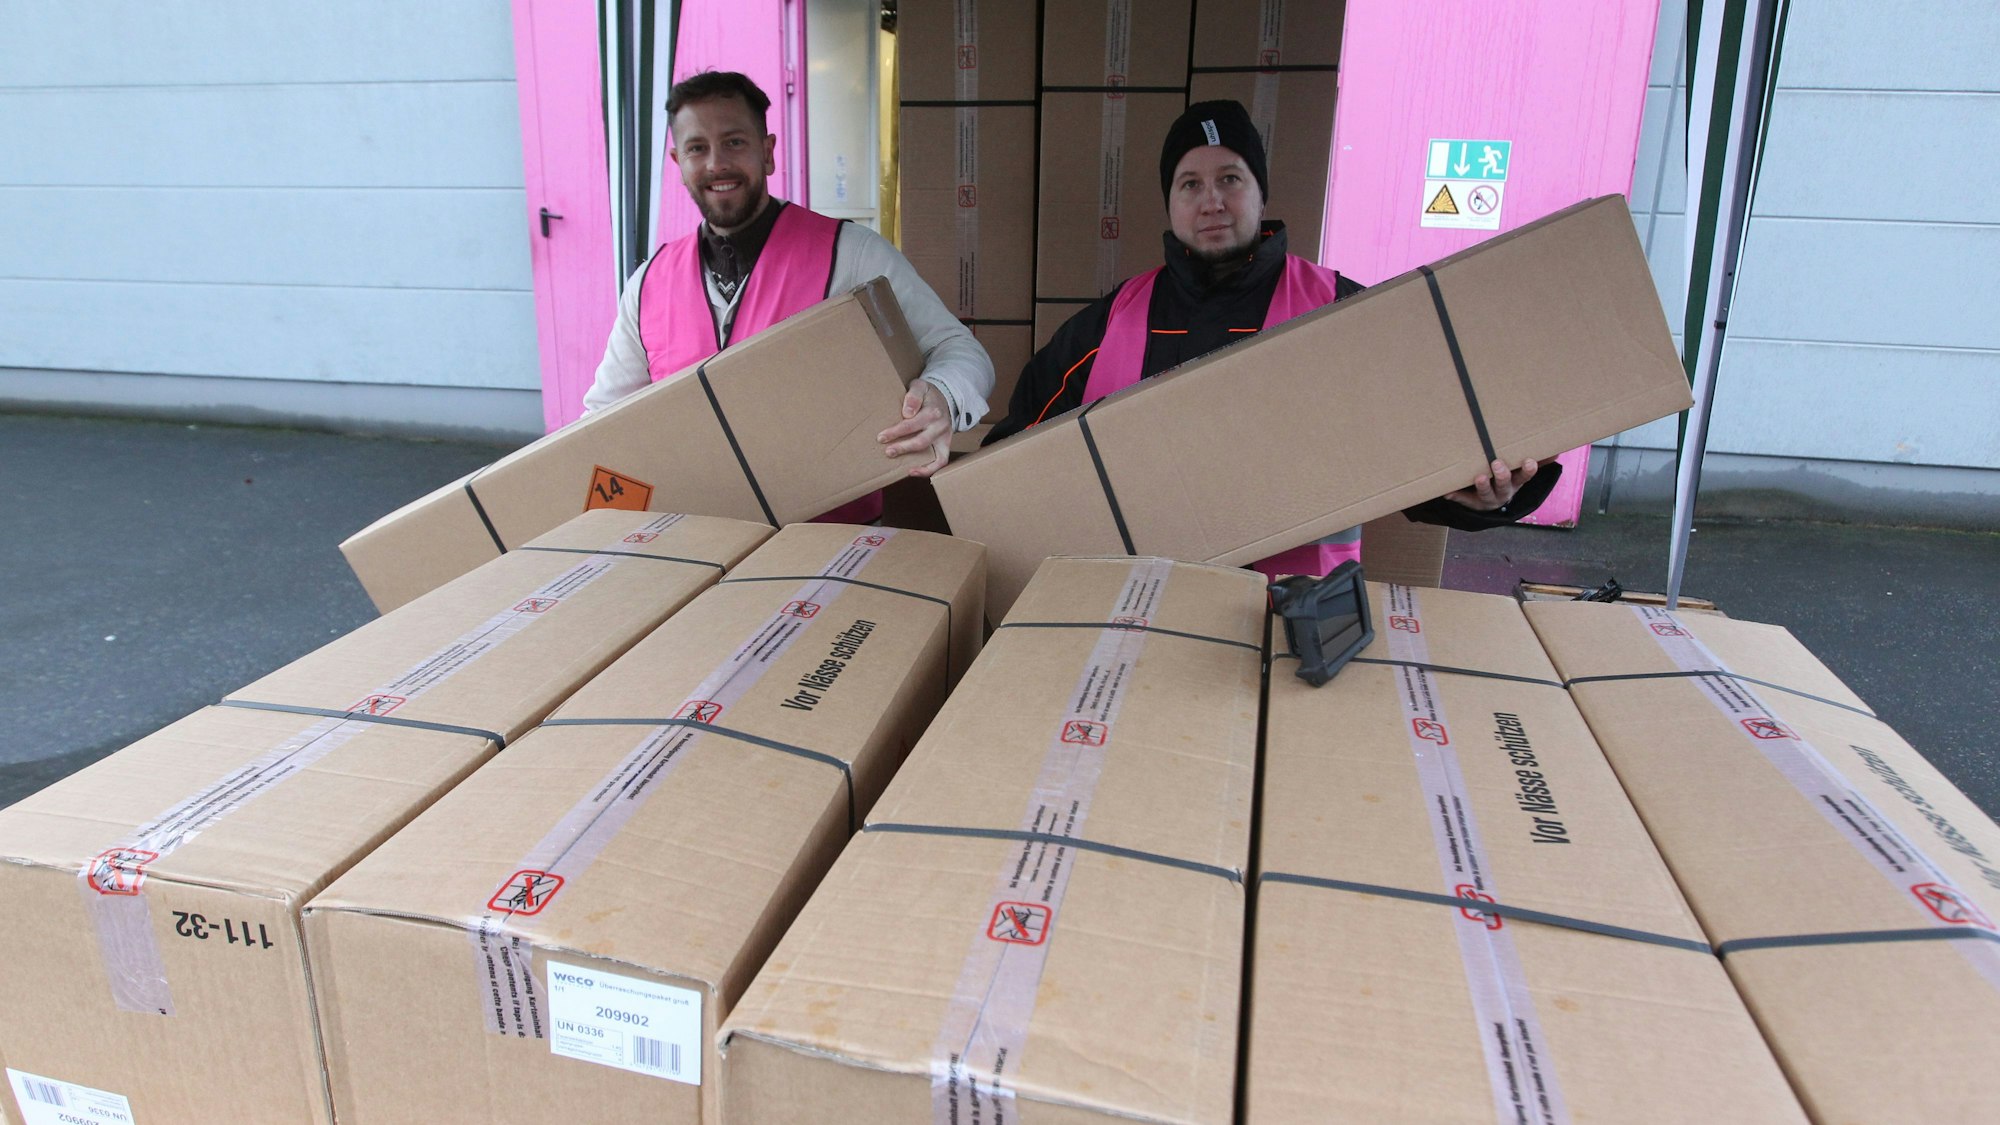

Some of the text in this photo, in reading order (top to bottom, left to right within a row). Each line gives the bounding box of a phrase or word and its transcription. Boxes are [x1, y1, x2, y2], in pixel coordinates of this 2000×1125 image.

[595, 476, 624, 503] 1.4
[830, 620, 876, 660] schützen
[798, 659, 846, 692] Nässe
[781, 690, 821, 711] Vor
[1493, 712, 1571, 844] Vor Nässe schützen
[1850, 744, 1934, 810] schützen
[1917, 807, 1991, 863] Nässe
[172, 910, 273, 949] 111-32
[491, 980, 499, 988] si
[554, 972, 594, 986] weco
[492, 988, 502, 1007] cette
[496, 1008, 506, 1029] bande
[512, 1007, 521, 1022] tape
[528, 996, 543, 1039] Kartoninhalt
[595, 1006, 650, 1028] 209902
[557, 1020, 604, 1039] UN 0336
[112, 1112, 127, 1121] UN
